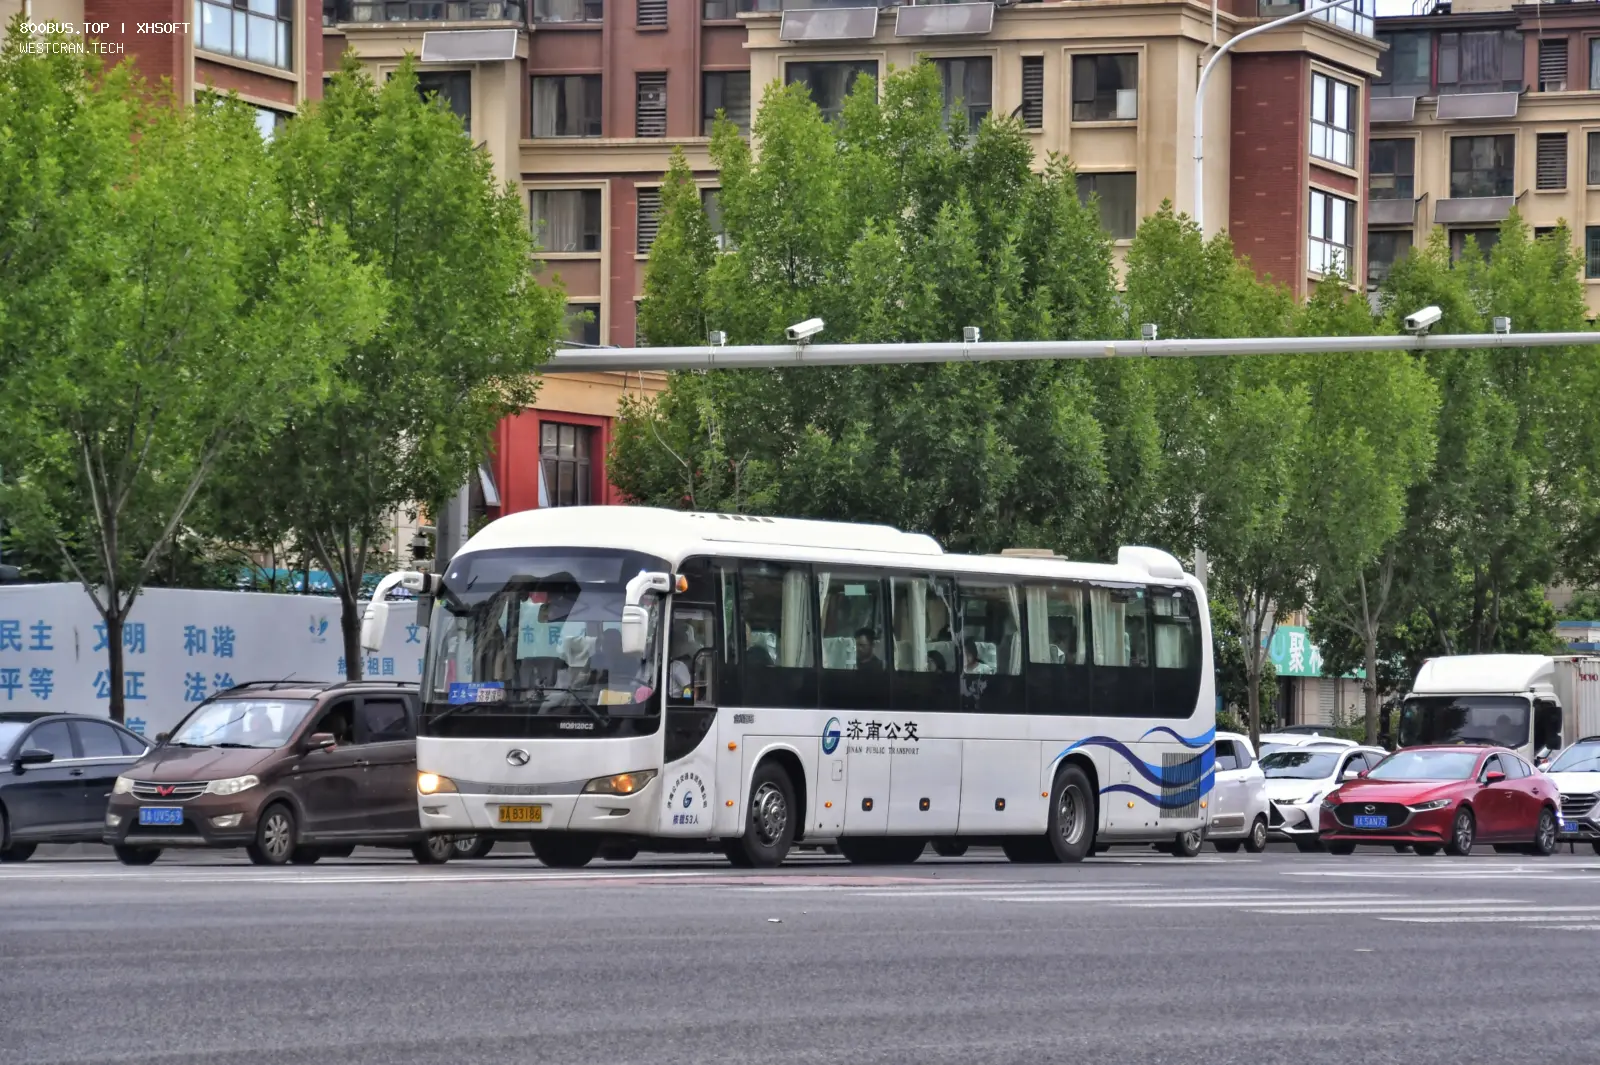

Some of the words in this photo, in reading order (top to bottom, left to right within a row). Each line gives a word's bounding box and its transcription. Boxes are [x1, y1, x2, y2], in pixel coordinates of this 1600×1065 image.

[0, 620, 54, 652] 民主
[93, 620, 146, 654] 文明
[184, 625, 236, 658] 和谐
[0, 667, 54, 700] 平等
[92, 669, 147, 700] 公正
[846, 719, 919, 742] 济南公交
[846, 746, 862, 754] JINAN
[866, 746, 885, 755] PUBLIC
[889, 747, 919, 755] TRANSPORT
